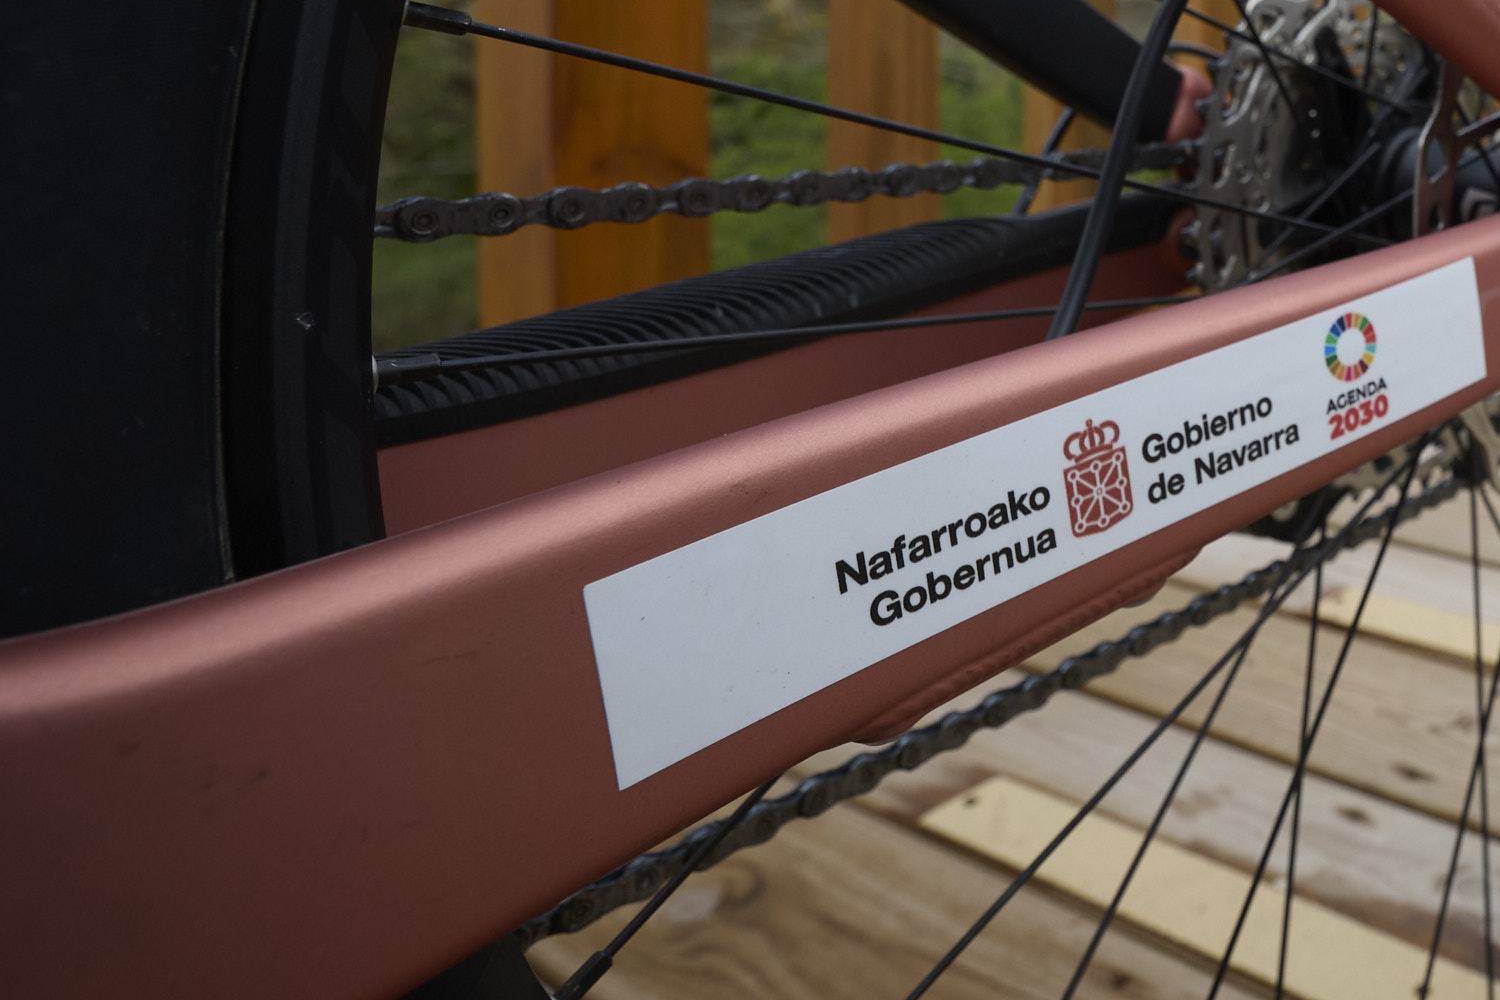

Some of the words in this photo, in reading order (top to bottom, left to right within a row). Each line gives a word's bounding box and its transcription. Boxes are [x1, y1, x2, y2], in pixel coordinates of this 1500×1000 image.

[1141, 395, 1273, 465] Gobierno
[1325, 376, 1388, 415] AGENDA
[1328, 393, 1390, 442] 2030
[1147, 472, 1187, 505] de
[1194, 423, 1301, 485] Navarra
[834, 483, 1052, 595] Nafarroako
[869, 526, 1058, 628] Gobernua
